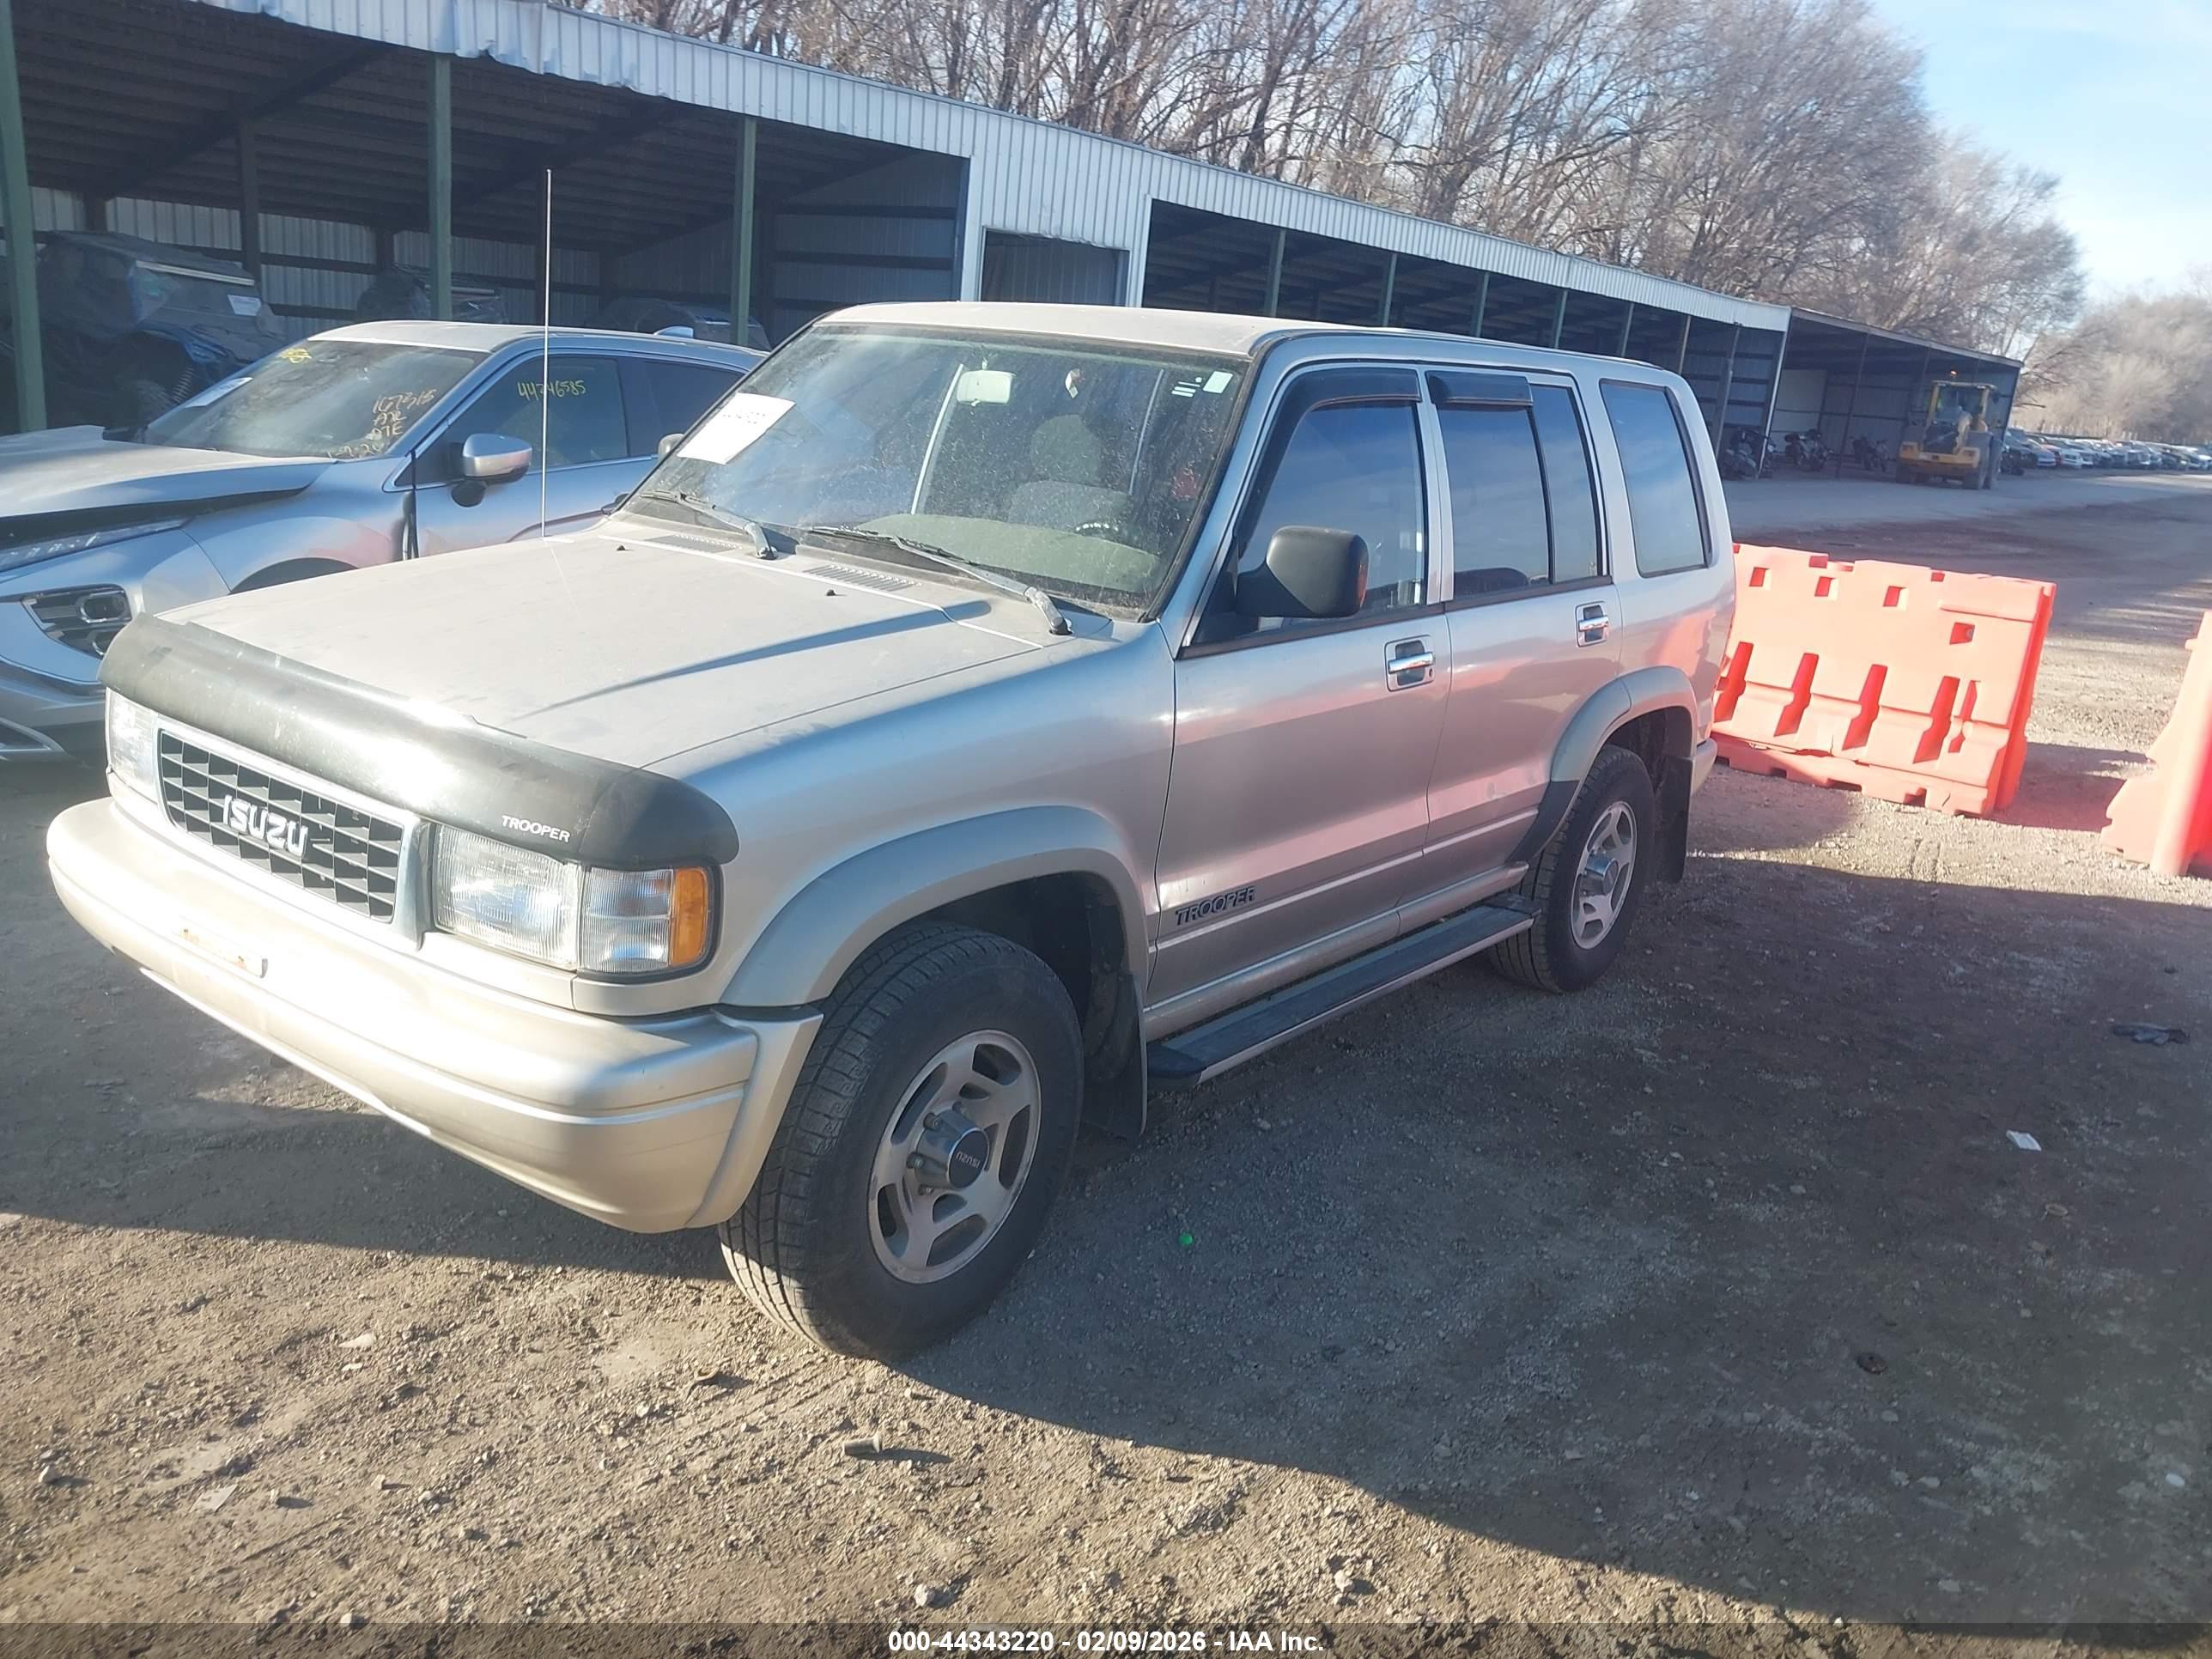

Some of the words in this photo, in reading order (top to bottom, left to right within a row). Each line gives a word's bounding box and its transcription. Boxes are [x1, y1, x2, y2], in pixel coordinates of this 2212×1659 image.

[223, 794, 309, 856] ISUZU
[501, 815, 570, 843] TROOPER
[1176, 885, 1255, 926] TROOPER
